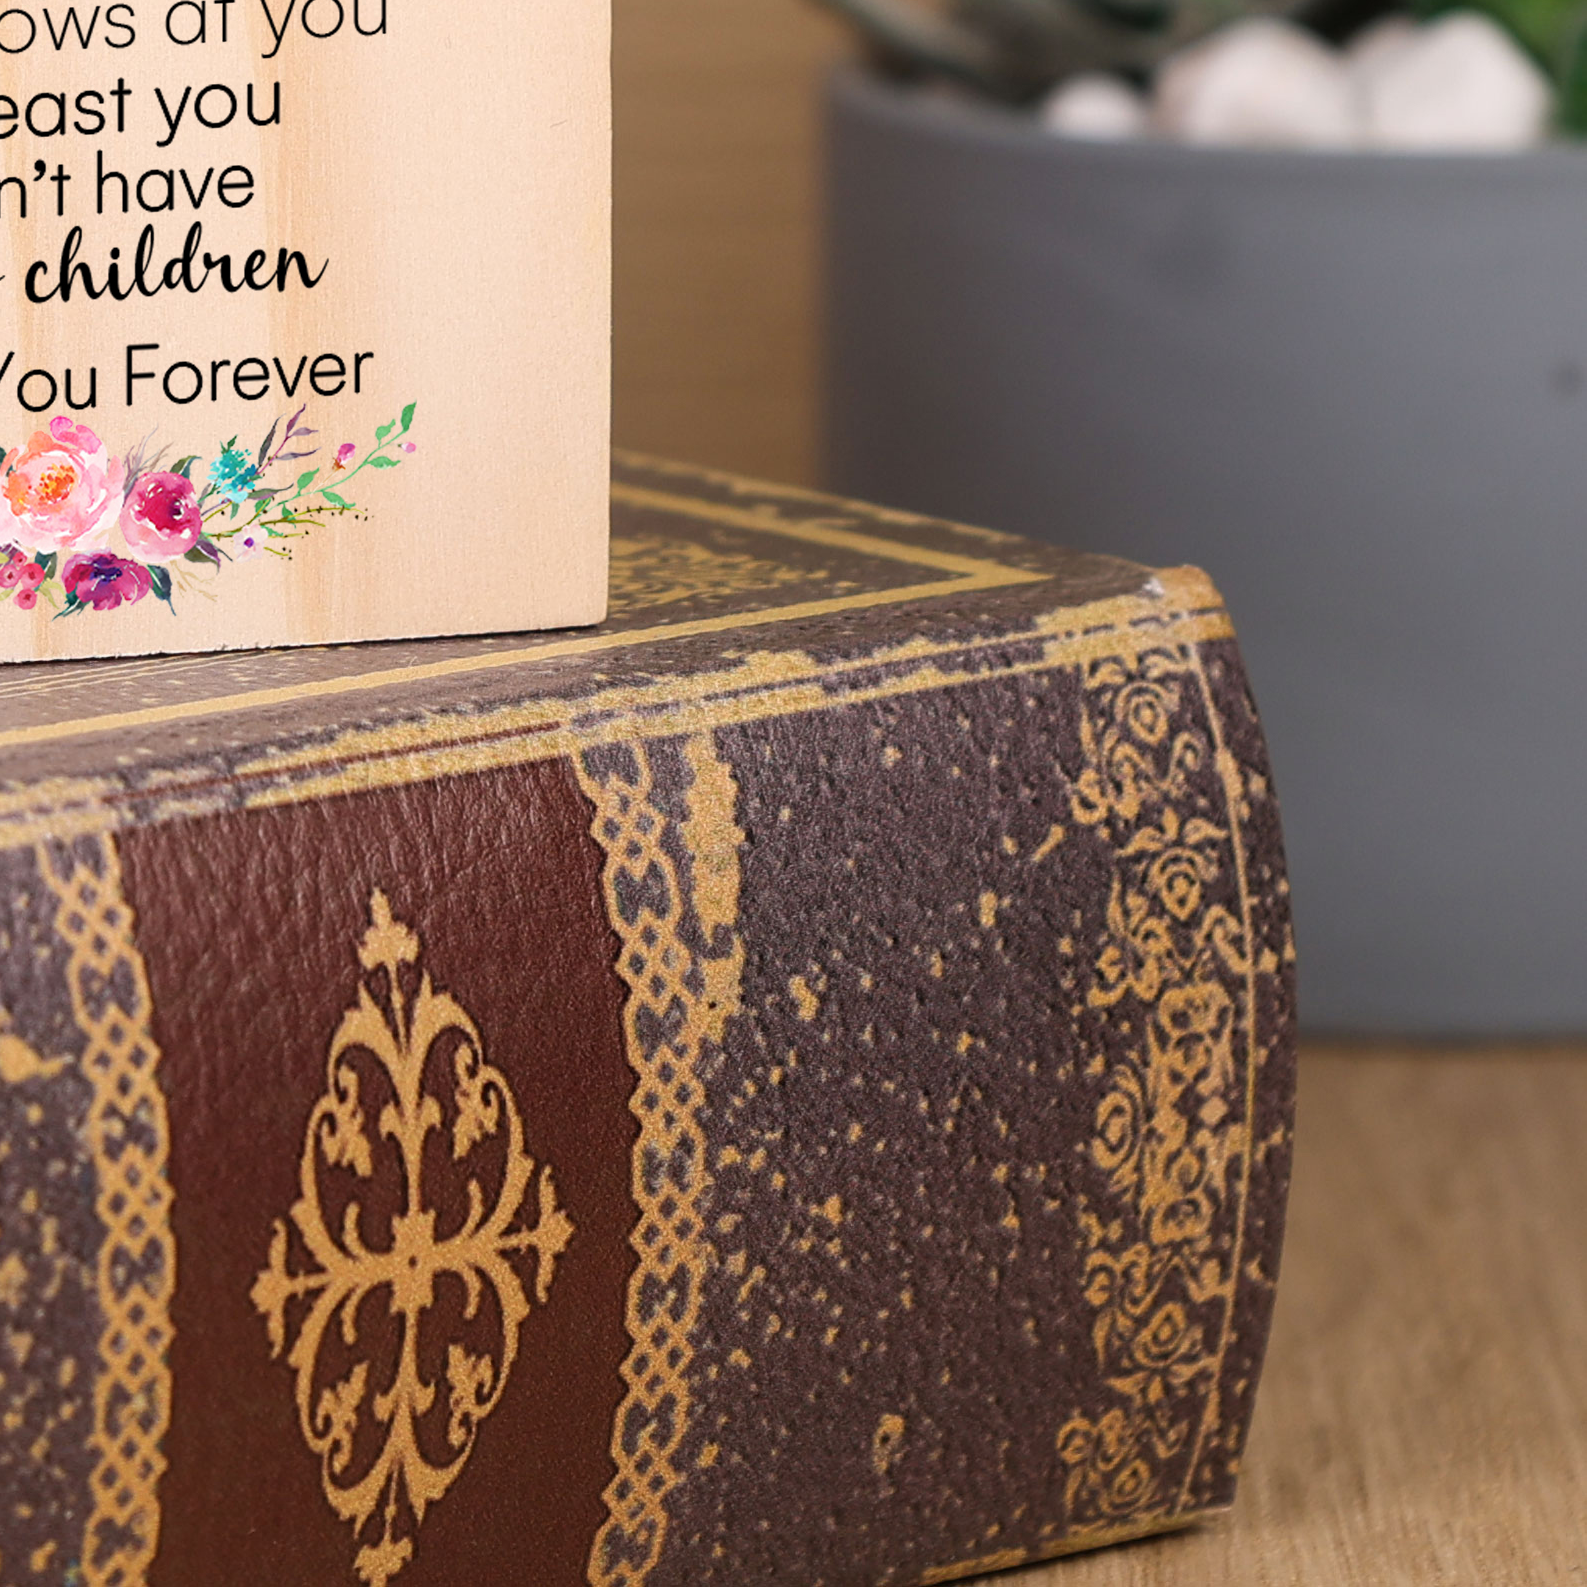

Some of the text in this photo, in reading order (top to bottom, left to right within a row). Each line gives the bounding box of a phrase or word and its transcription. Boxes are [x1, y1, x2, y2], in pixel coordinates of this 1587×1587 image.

[153, 81, 281, 148] you
[95, 149, 255, 215] have
[23, 220, 330, 304] children
[125, 342, 375, 407] Forever
